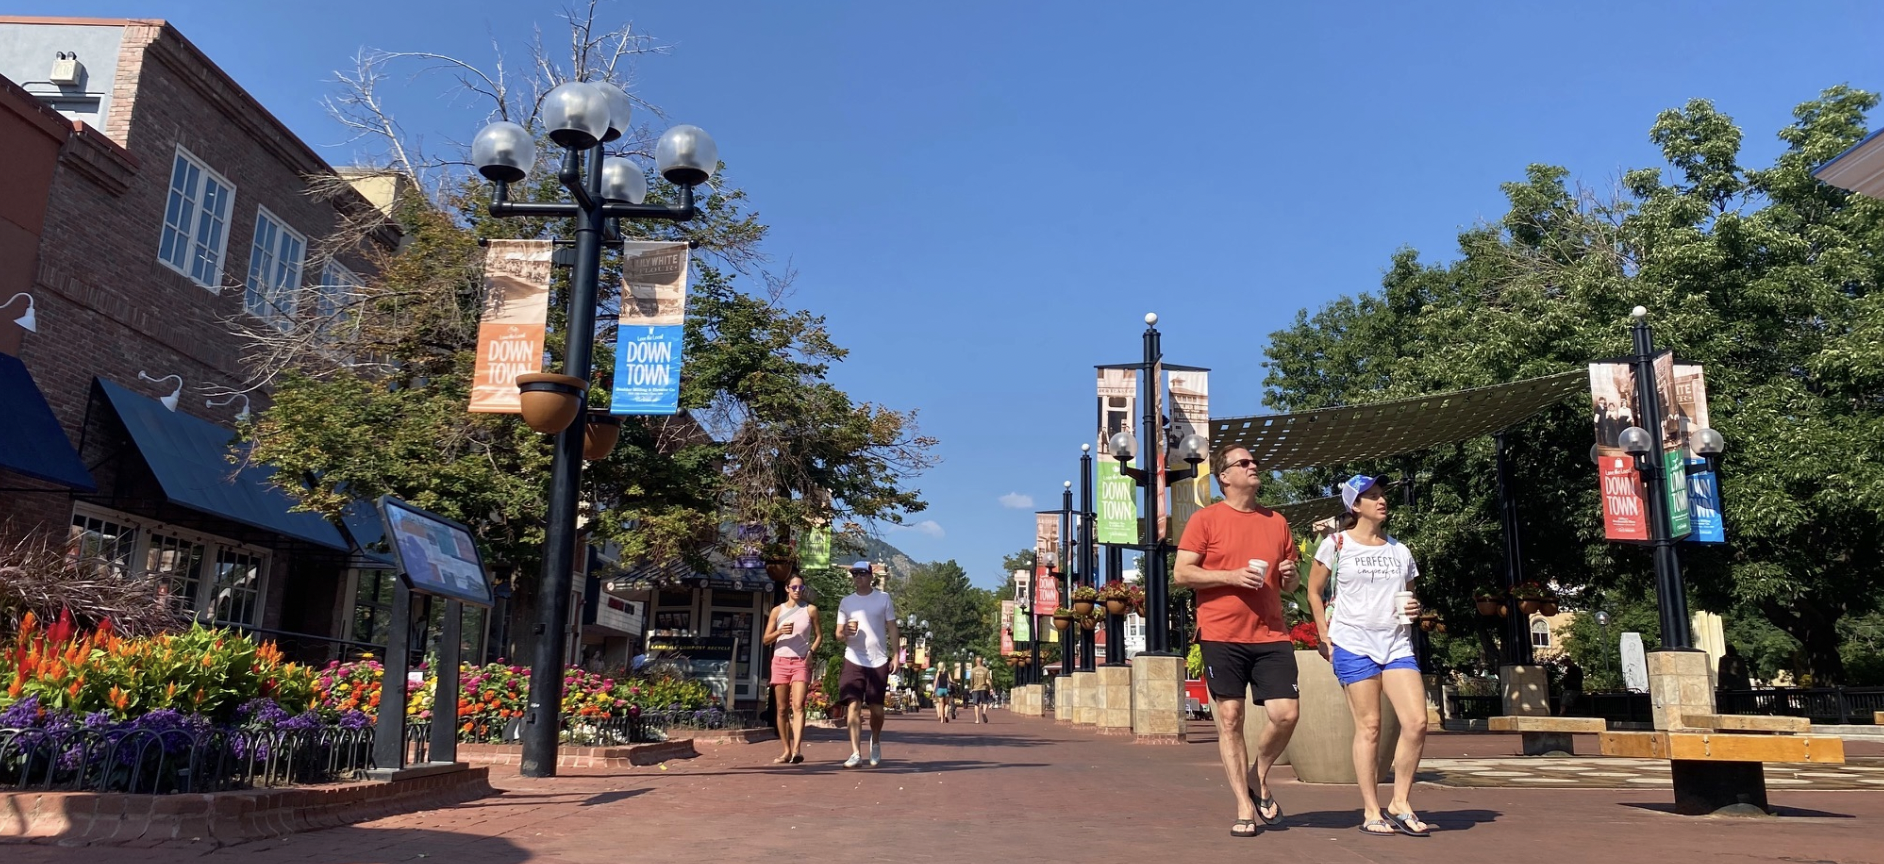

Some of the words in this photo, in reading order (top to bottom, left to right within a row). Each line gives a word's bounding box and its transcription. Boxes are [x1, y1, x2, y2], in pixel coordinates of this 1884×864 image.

[651, 254, 679, 267] WHITE
[488, 340, 534, 362] DOWN
[626, 341, 672, 364] DOWN
[626, 363, 670, 386] TOWN
[1102, 481, 1132, 501] DOWN
[1605, 476, 1635, 496] DOWN
[1687, 478, 1712, 498] OWN
[1101, 501, 1132, 521] TOWN
[1176, 502, 1201, 523] TO
[1606, 495, 1639, 516] TOWN
[1688, 498, 1716, 518] OWN
[1039, 589, 1056, 601] TOWN
